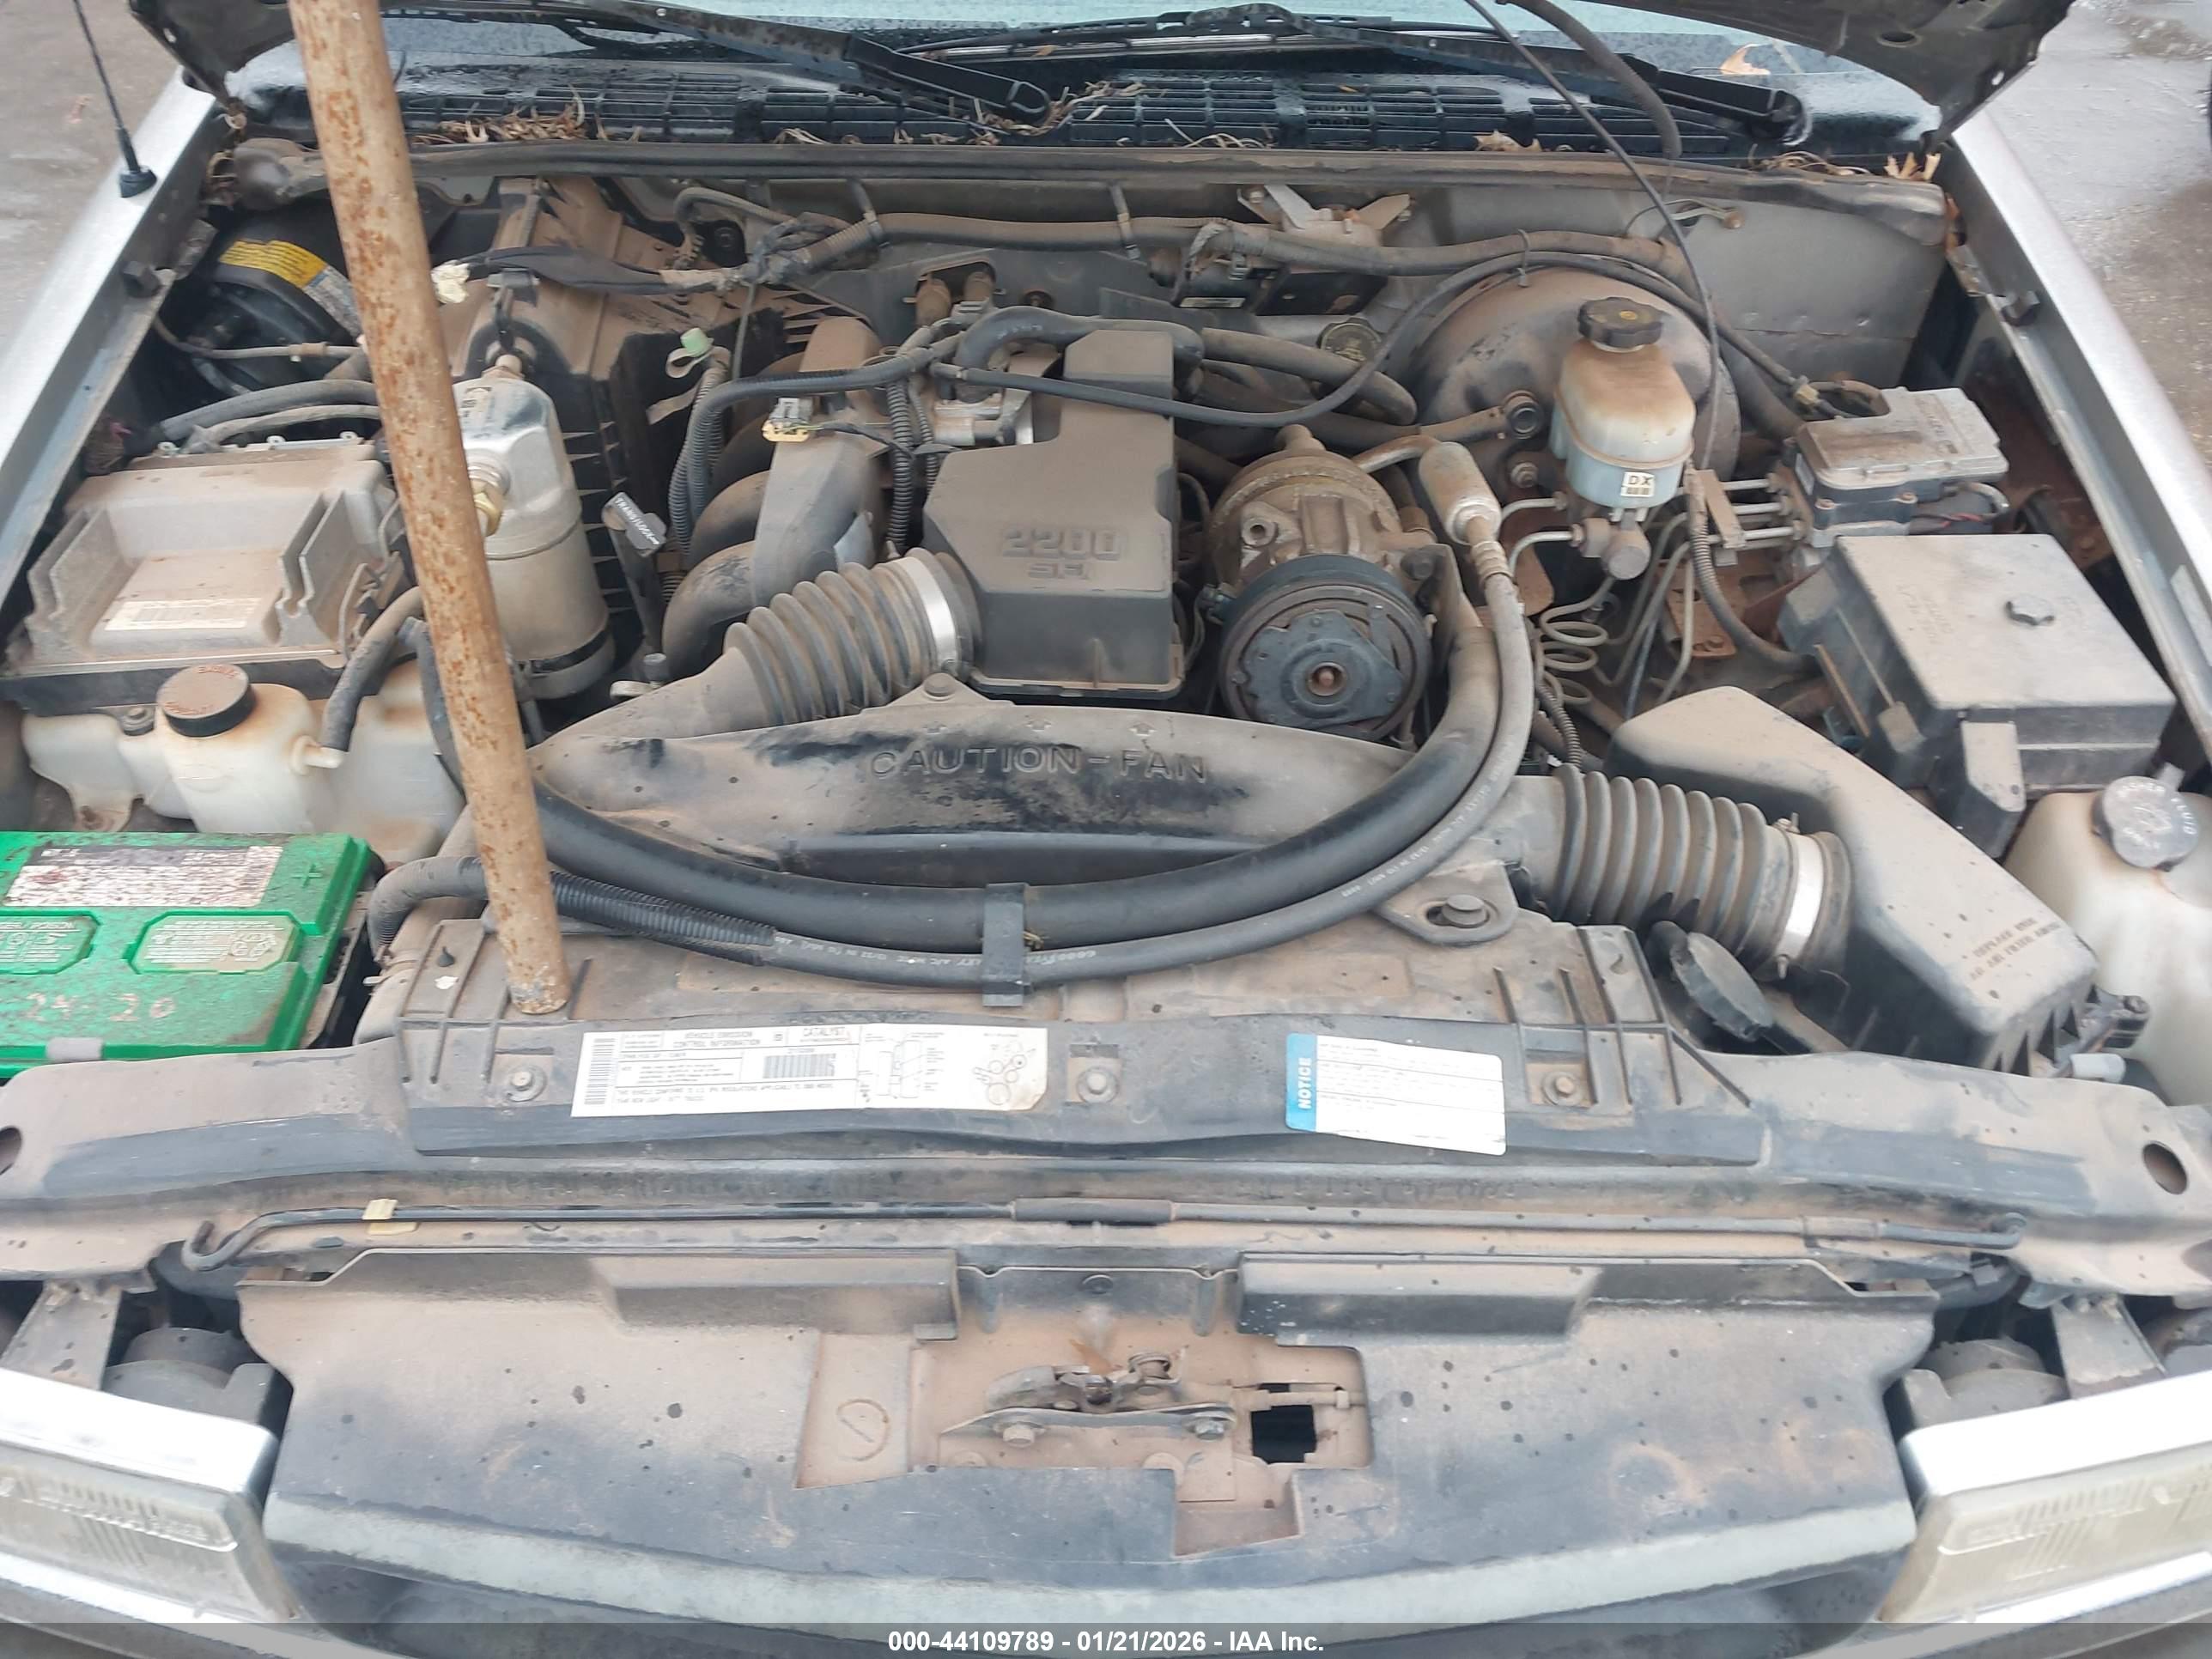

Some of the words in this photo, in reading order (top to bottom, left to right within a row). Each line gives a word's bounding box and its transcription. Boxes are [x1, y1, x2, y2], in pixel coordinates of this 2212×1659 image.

[1627, 475, 1654, 486] DX
[1002, 526, 1121, 561] 2200
[870, 745, 1081, 779] CAUTION
[1121, 748, 1209, 783] FAN
[1297, 1056, 1312, 1110] NOTICE
